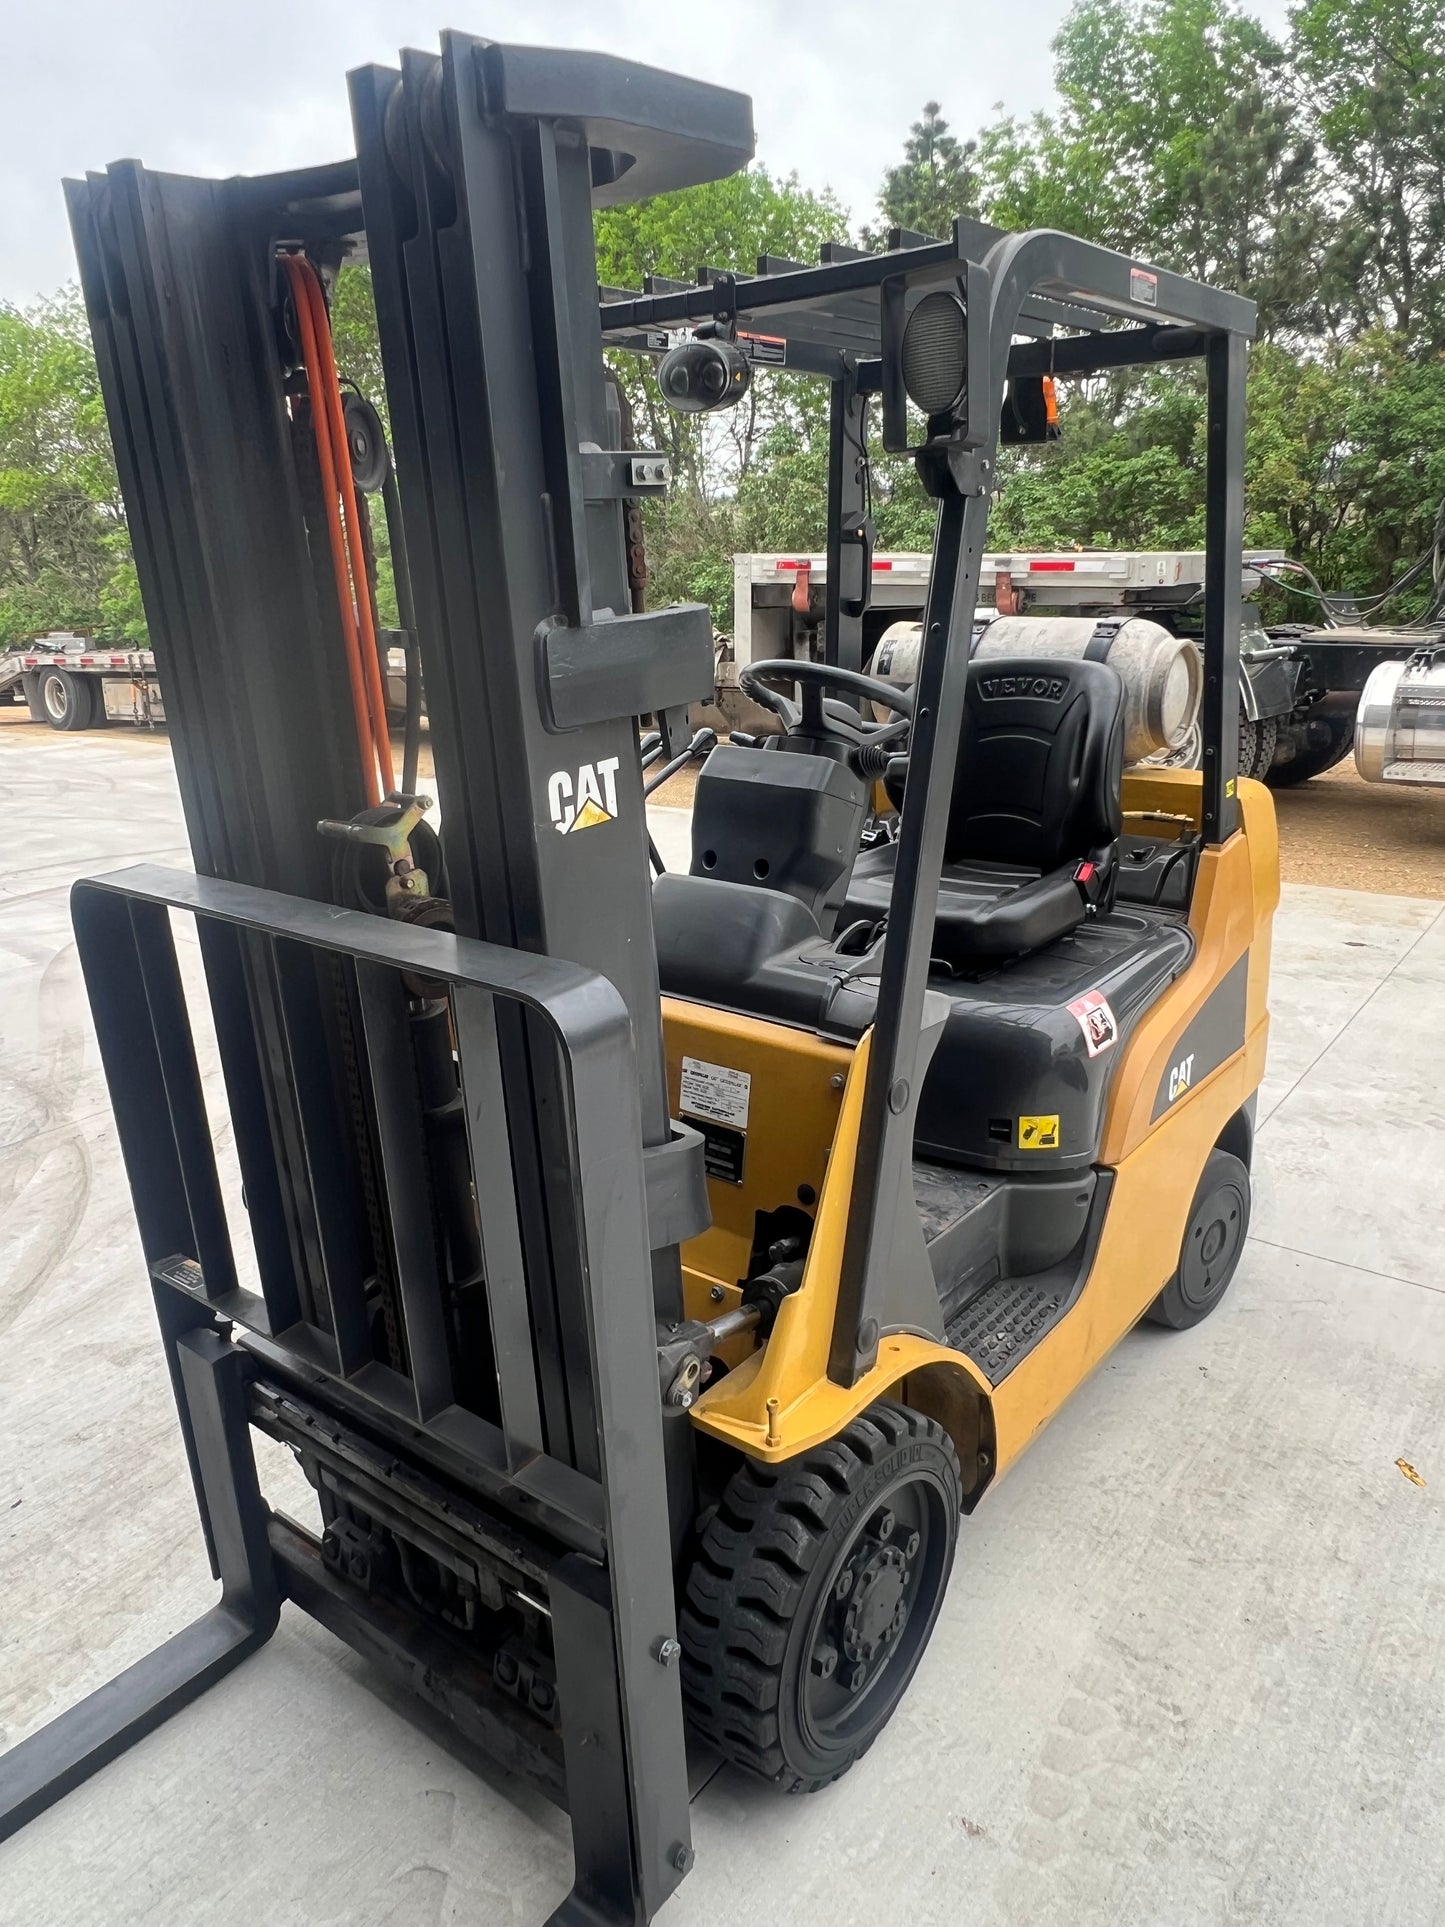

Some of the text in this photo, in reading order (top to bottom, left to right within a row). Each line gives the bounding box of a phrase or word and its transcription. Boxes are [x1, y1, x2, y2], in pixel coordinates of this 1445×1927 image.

[983, 678, 1062, 697] VEVOR
[548, 756, 620, 835] CAT
[1168, 1053, 1195, 1102] CAT
